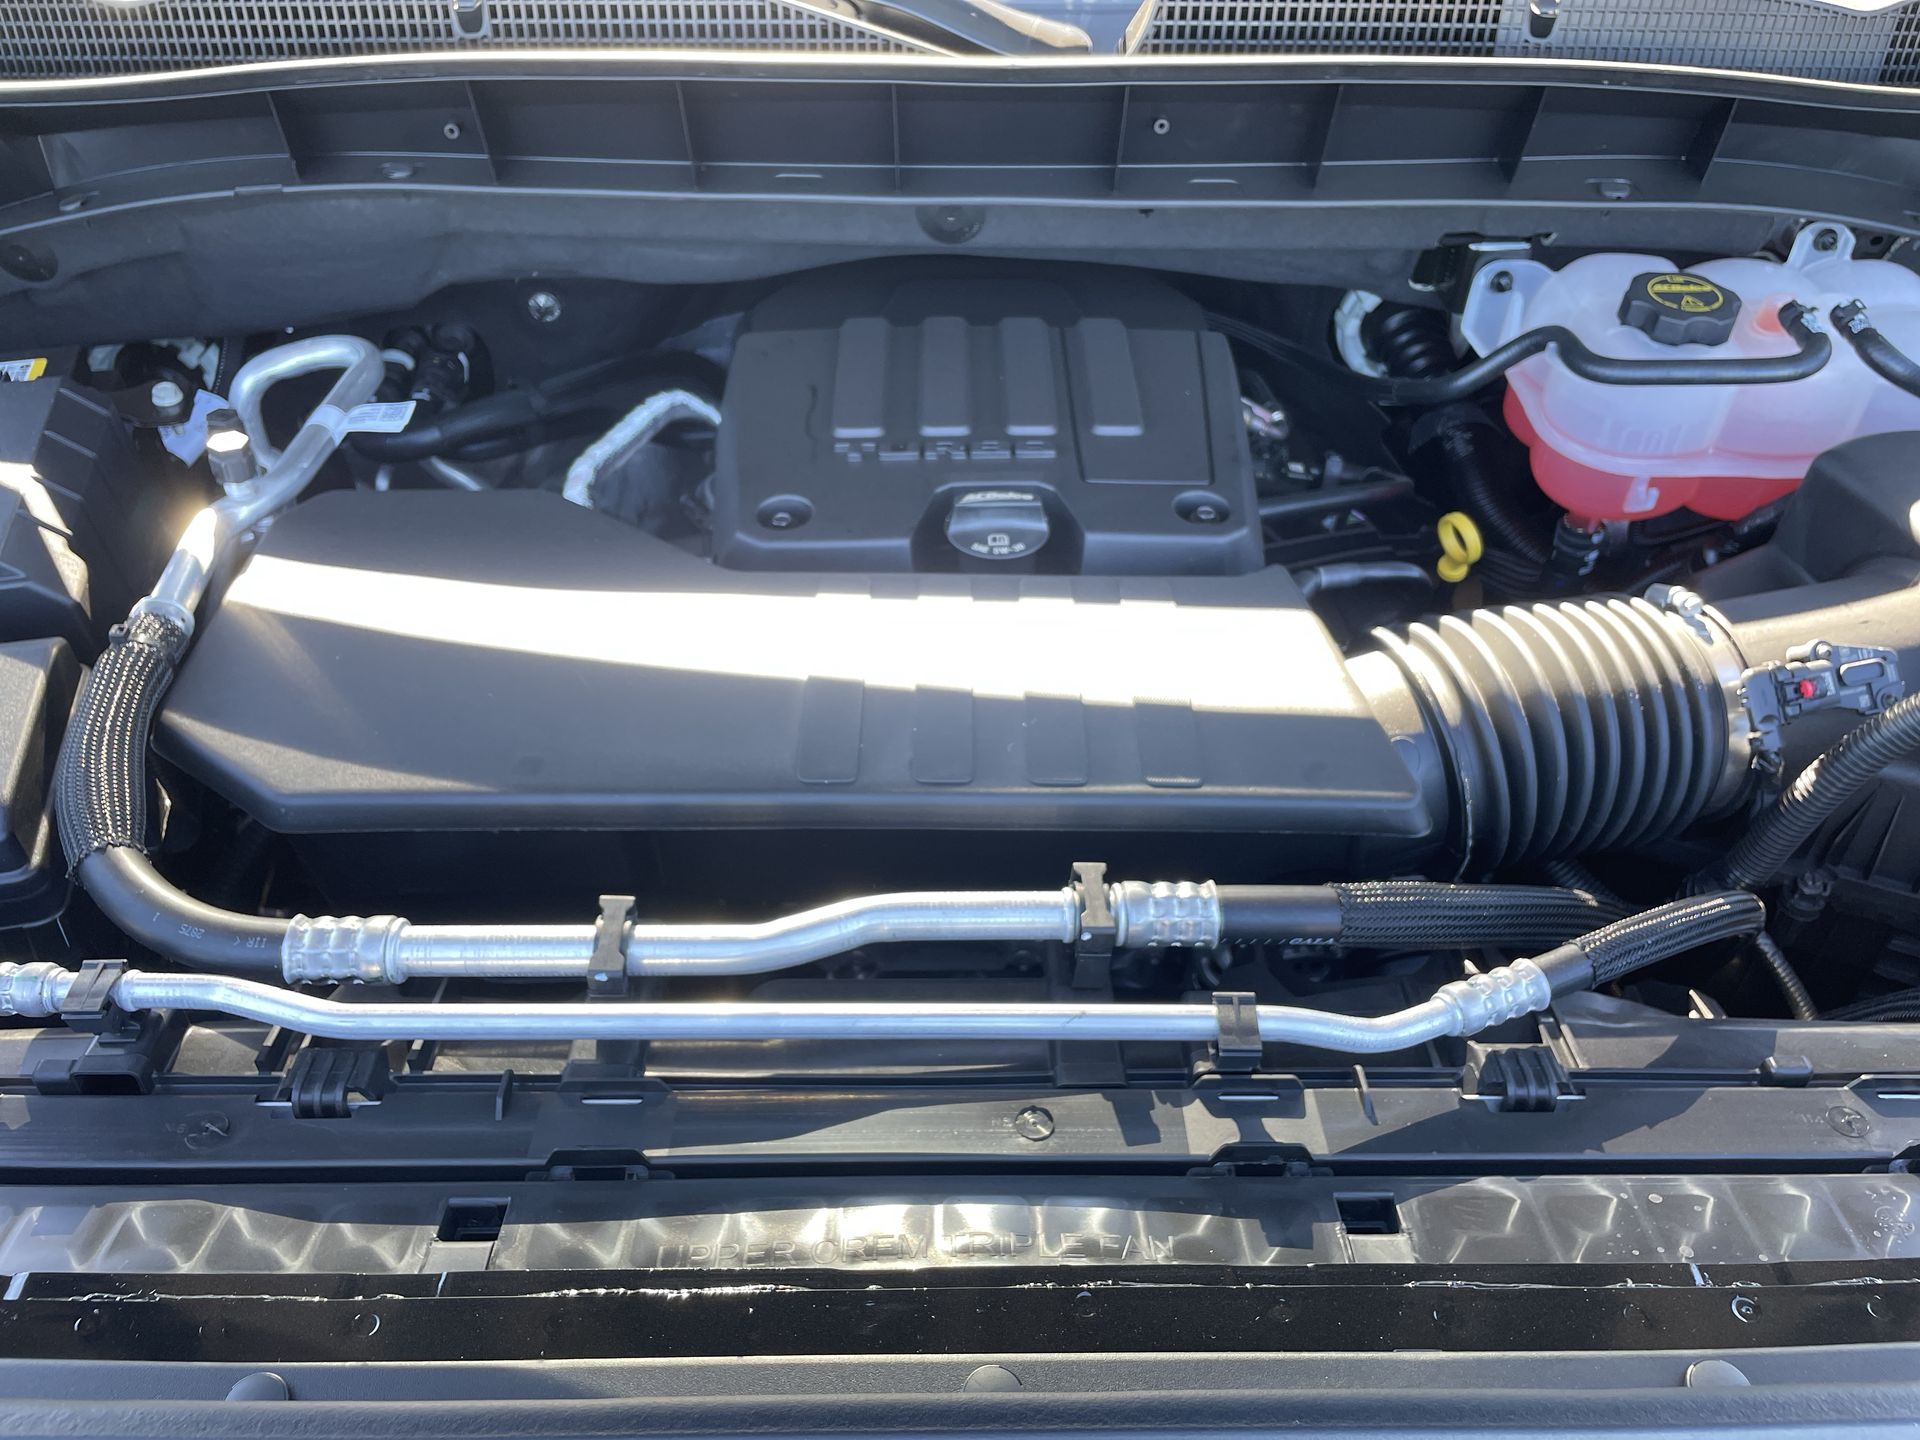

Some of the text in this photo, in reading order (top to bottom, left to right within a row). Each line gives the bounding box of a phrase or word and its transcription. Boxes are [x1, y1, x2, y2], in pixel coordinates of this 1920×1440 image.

[655, 1239, 798, 1269] UPPER
[943, 1231, 1086, 1259] TRIPLE
[1099, 1233, 1175, 1261] FAN
